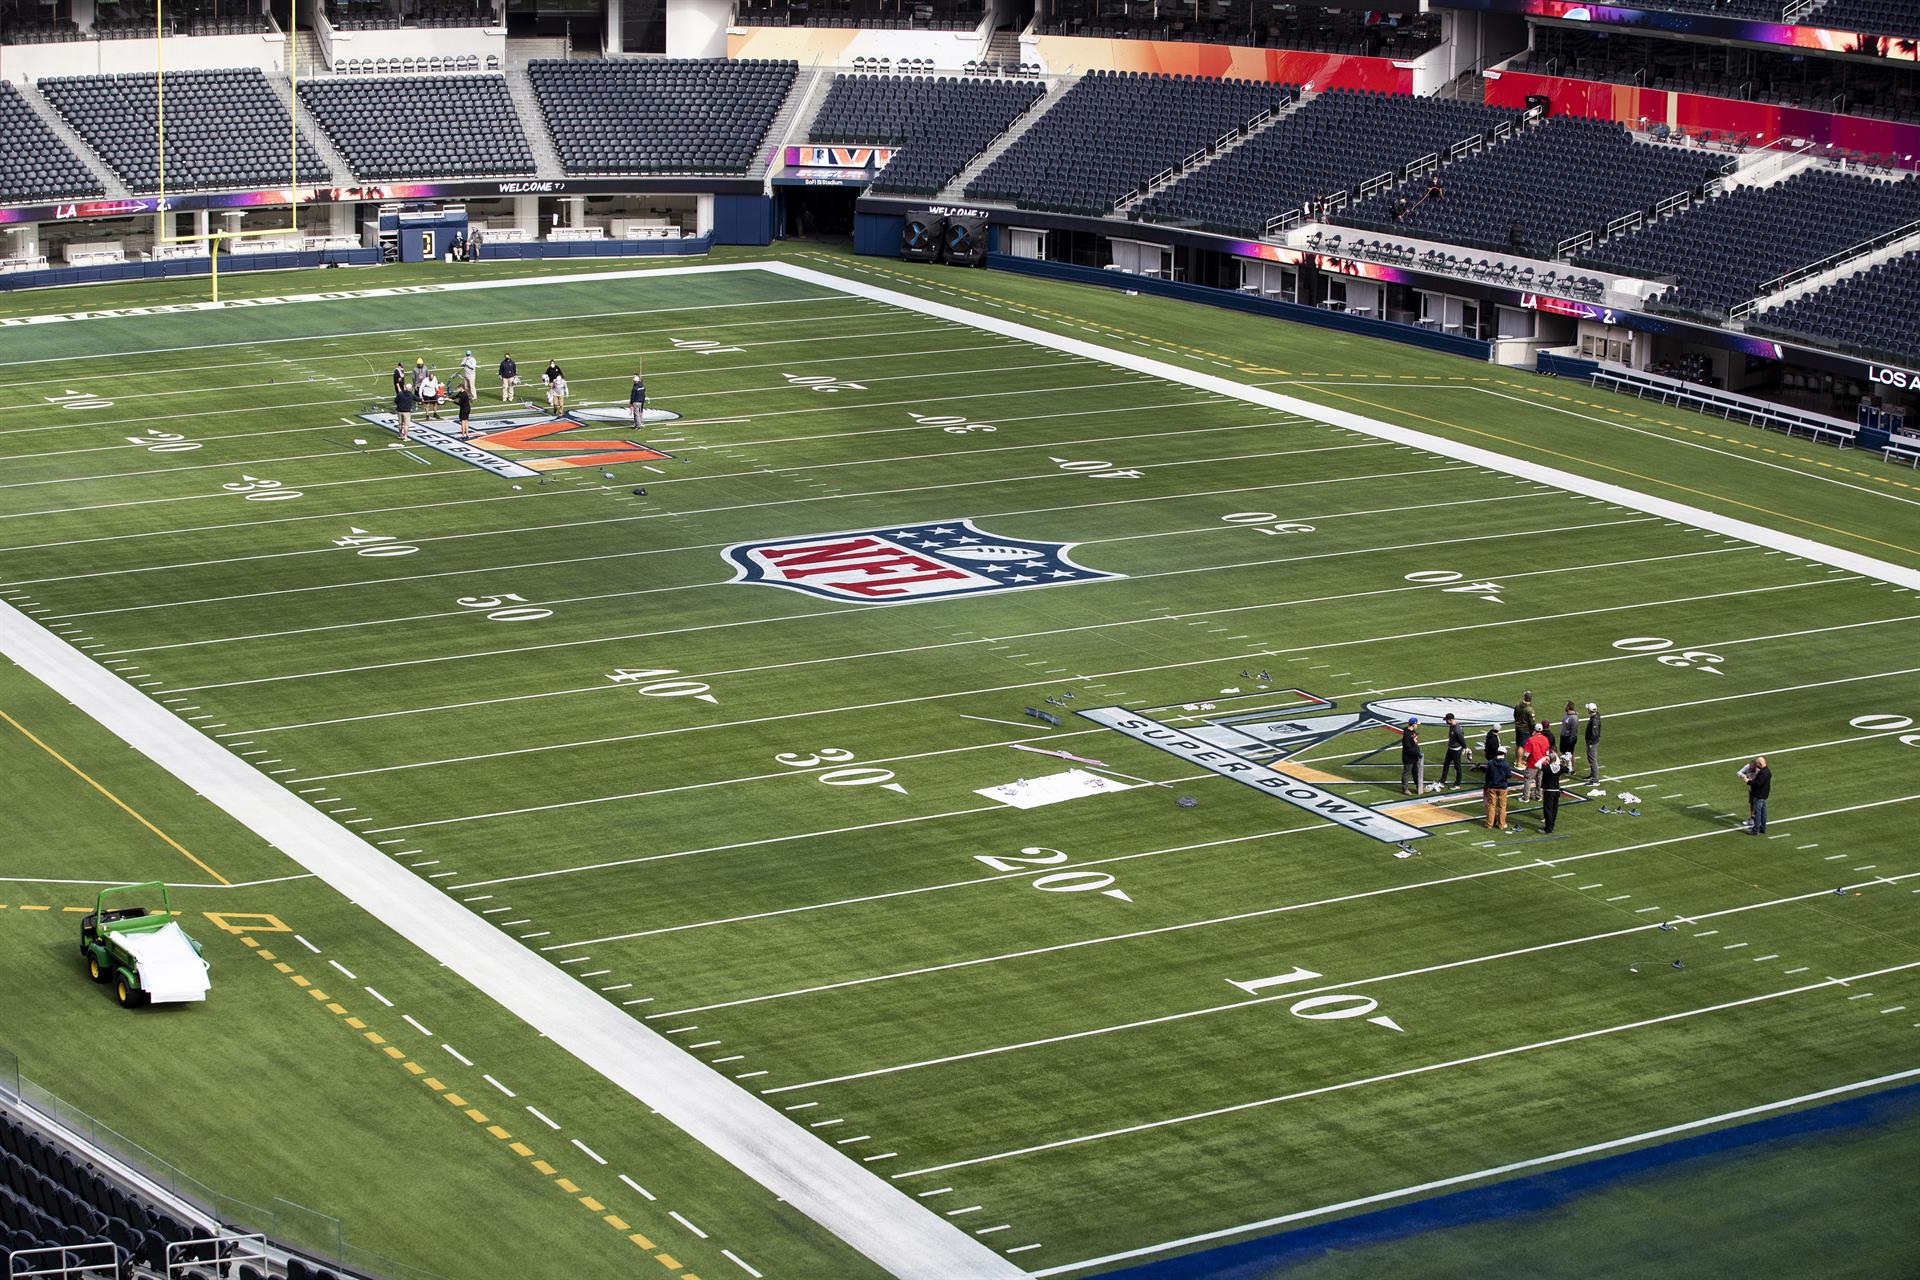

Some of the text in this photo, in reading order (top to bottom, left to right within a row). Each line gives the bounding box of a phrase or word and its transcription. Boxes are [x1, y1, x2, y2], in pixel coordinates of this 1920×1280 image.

[499, 182, 552, 192] WELCOME
[56, 204, 77, 219] LA
[929, 206, 978, 217] WELCOME
[54, 304, 201, 320] TAKES
[222, 297, 303, 309] ALL
[319, 292, 371, 300] OF
[388, 285, 446, 293] US
[1520, 292, 1538, 310] LA
[1869, 366, 1907, 388] LOS
[44, 392, 115, 410] 10
[125, 432, 204, 452] 20
[449, 446, 512, 471] BOWL
[222, 479, 304, 501] 30
[331, 534, 420, 557] 40
[757, 537, 973, 597] NFL
[456, 593, 554, 622] 50
[604, 668, 711, 698] 40
[774, 747, 896, 786] 30
[1116, 719, 1377, 827] SUPER BOWL
[972, 846, 1116, 893] 20
[1224, 966, 1379, 1020] 10
